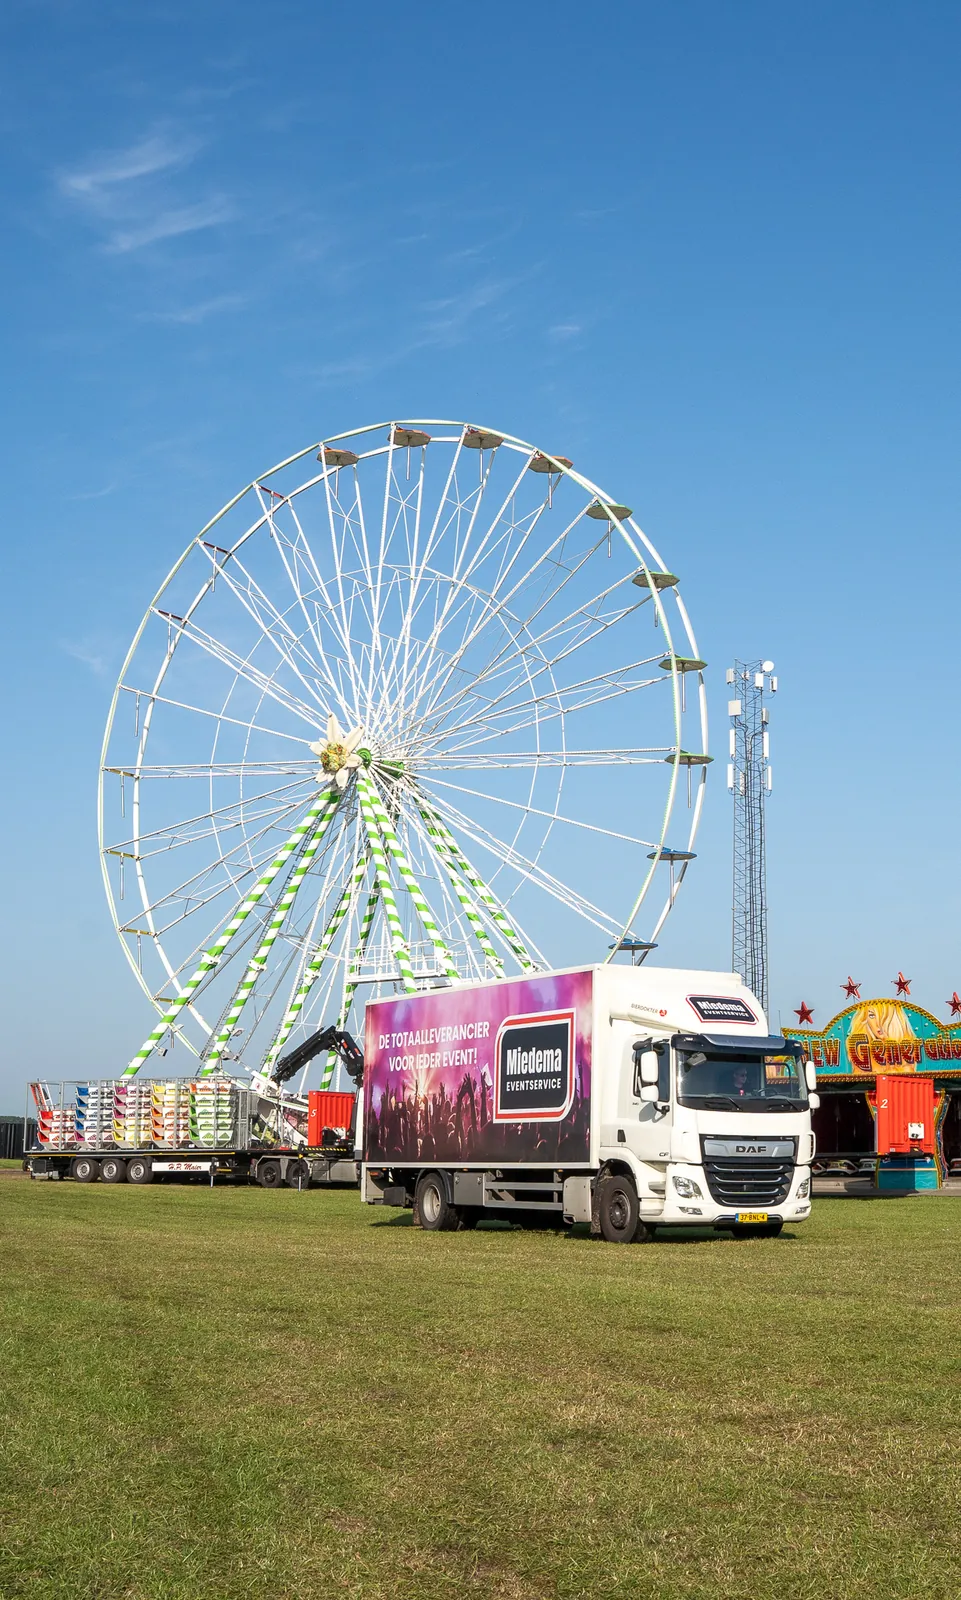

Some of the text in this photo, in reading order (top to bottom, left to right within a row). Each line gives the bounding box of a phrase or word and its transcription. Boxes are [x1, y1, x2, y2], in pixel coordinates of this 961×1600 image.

[696, 1001, 746, 1012] Miedema
[703, 1010, 750, 1018] EVENTSERVICE
[379, 1021, 490, 1050] DE TOTAALLEVERANCIER
[389, 1048, 478, 1072] VOOR IEDER EVENT!
[506, 1047, 562, 1076] Miedema
[506, 1078, 562, 1092] EVENTSERVICE
[880, 1098, 889, 1109] 2
[310, 1109, 318, 1118] 5
[735, 1145, 767, 1154] DAF
